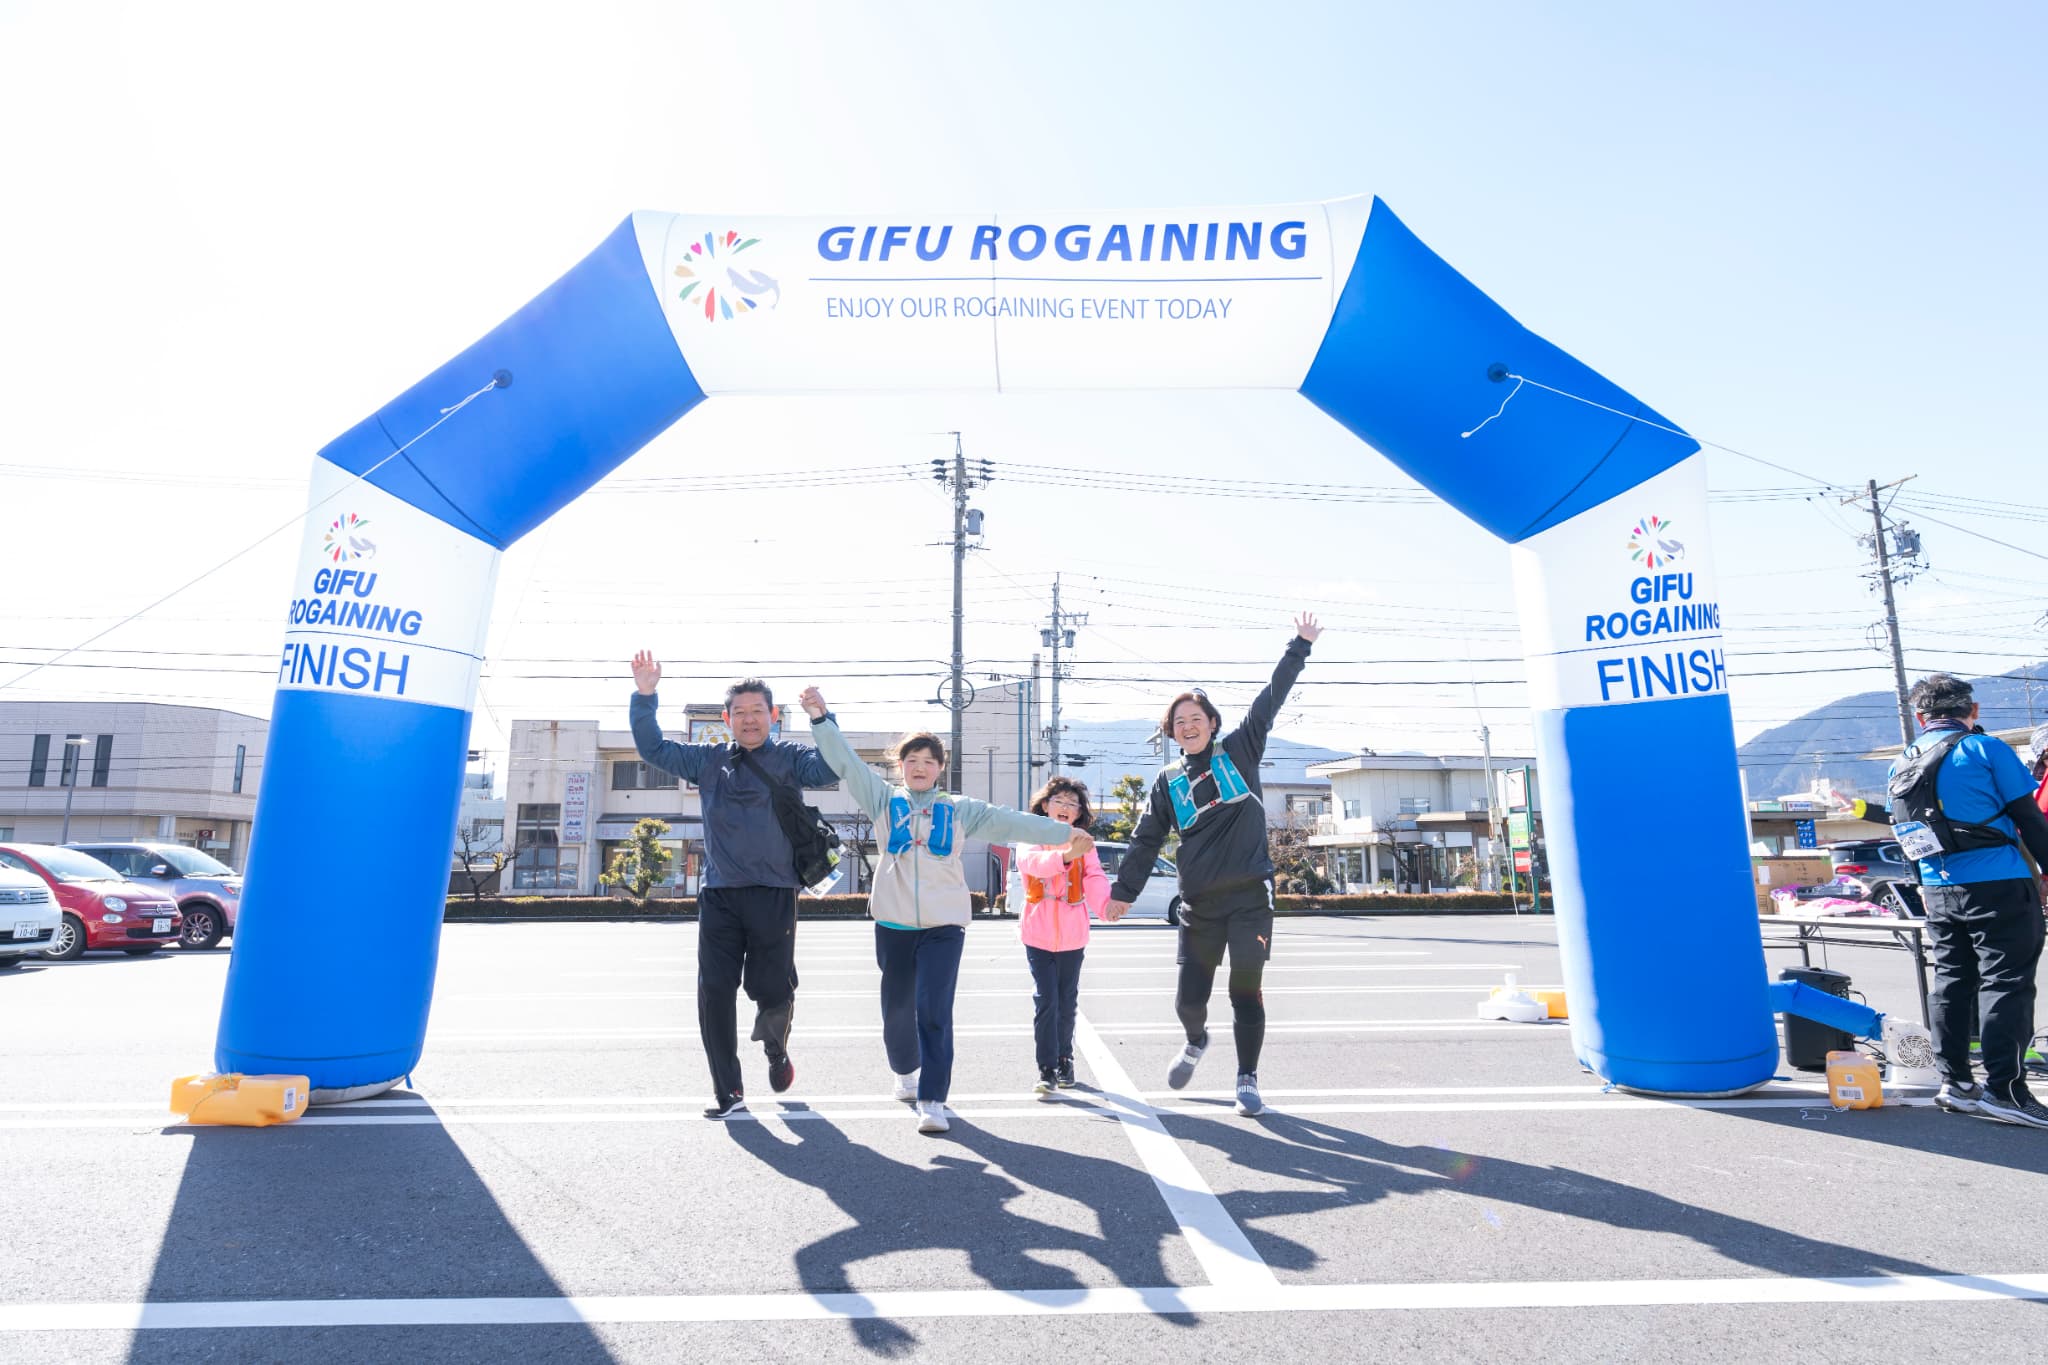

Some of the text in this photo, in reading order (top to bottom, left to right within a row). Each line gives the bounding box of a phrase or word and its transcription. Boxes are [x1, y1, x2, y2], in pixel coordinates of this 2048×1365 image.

[817, 220, 1308, 262] GIFU ROGAINING
[827, 297, 1232, 320] ENJOY OUR ROGAINING EVENT TODAY
[313, 567, 378, 598] GIFU
[1630, 572, 1693, 605] GIFU
[1585, 602, 1721, 642] ROGAINING
[278, 643, 410, 695] FINISH
[1597, 648, 1727, 701] FINISH
